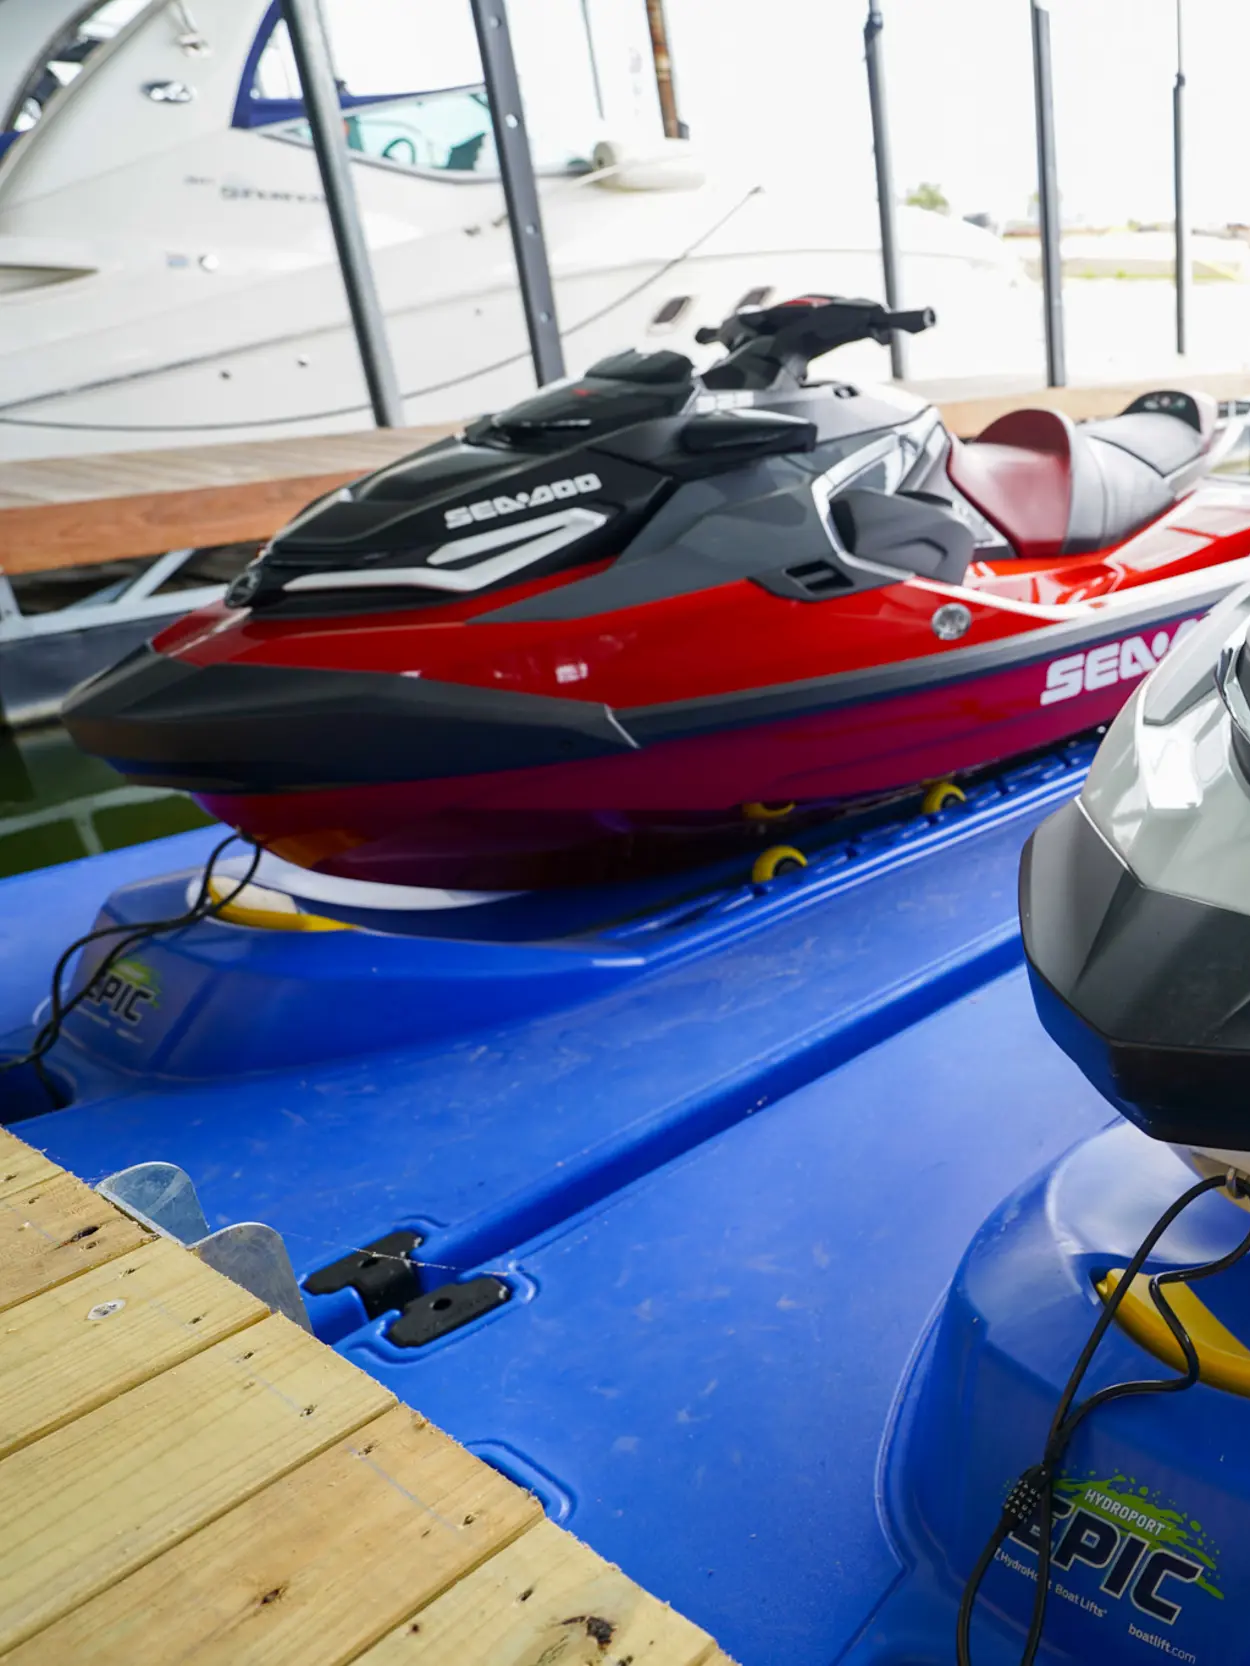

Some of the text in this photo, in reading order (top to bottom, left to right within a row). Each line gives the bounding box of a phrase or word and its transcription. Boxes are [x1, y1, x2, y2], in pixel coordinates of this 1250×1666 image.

[1084, 1487, 1165, 1537] HYDROPORT
[1055, 1583, 1081, 1603] Boat
[1128, 1623, 1197, 1664] boatlift.com
